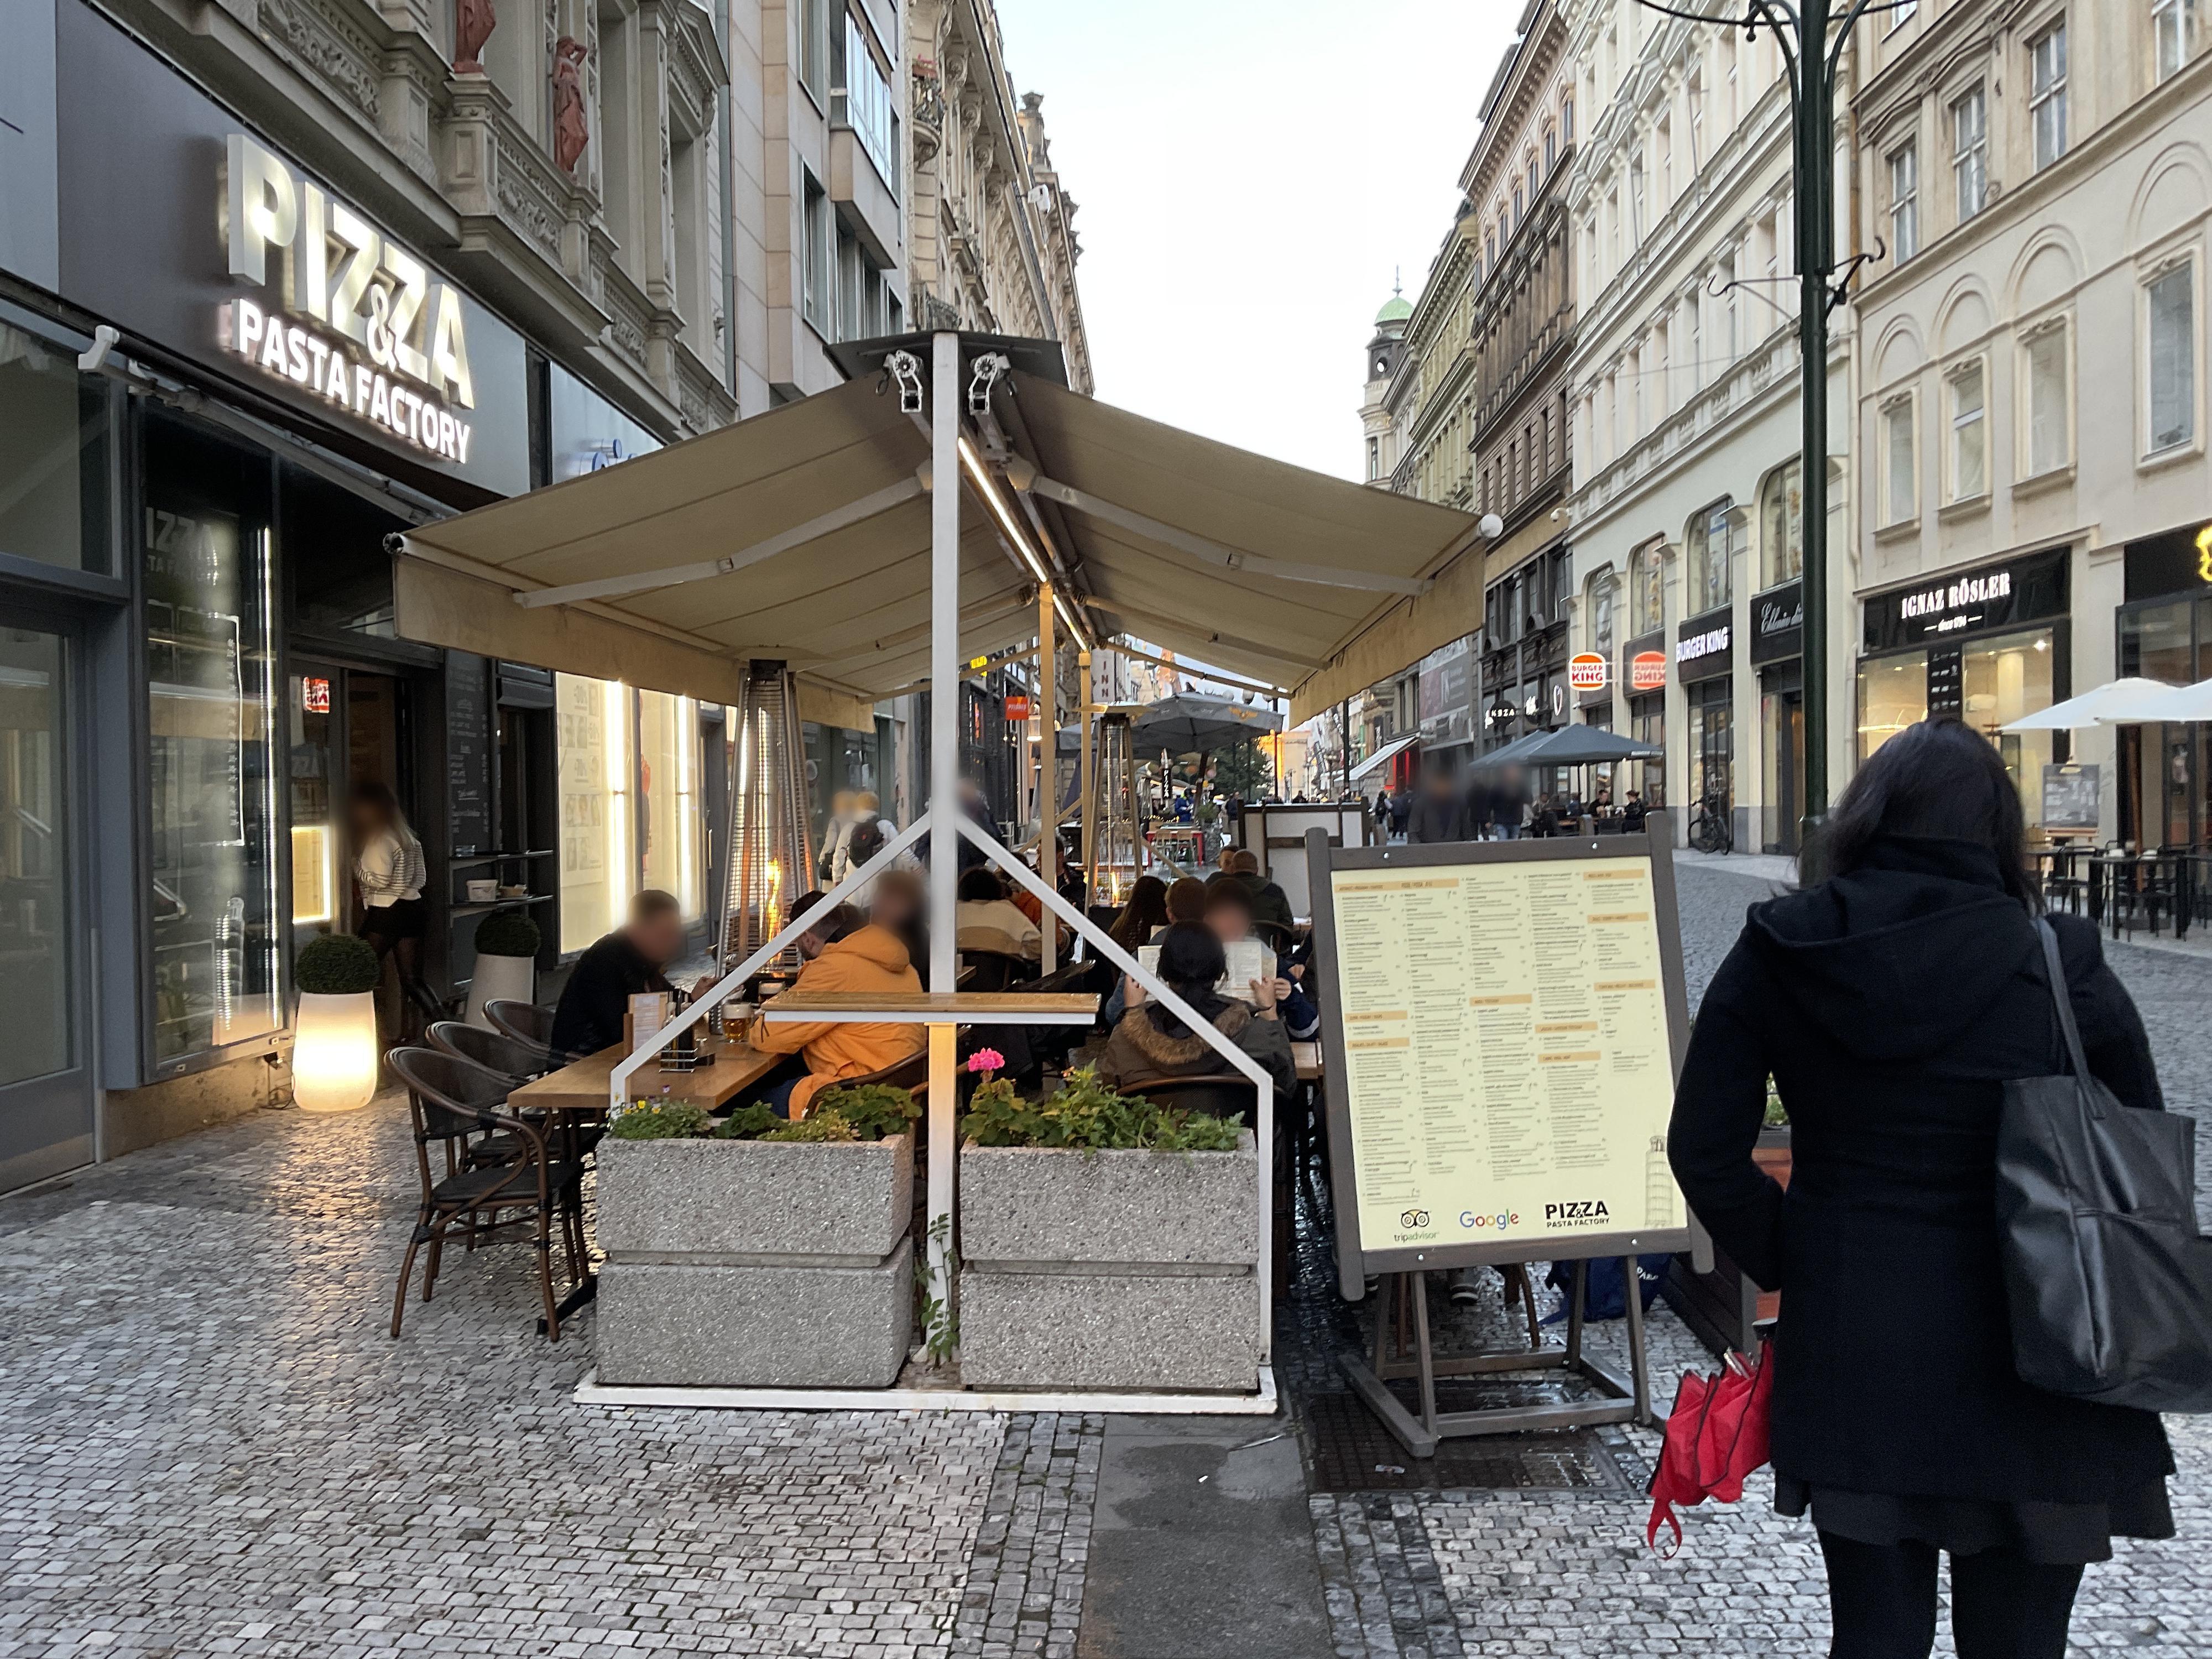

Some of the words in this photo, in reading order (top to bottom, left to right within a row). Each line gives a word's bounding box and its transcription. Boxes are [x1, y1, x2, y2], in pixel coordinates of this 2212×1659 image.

[227, 133, 474, 409] PIZZA
[231, 298, 348, 405] PASTA
[356, 364, 472, 464] FACTORY
[1901, 588, 1945, 619] IGNAZ
[1676, 634, 1706, 663] BURGER
[1705, 626, 1729, 654] KING
[1572, 672, 1603, 681] KING
[1459, 1209, 1520, 1230] Google
[1547, 1219, 1573, 1228] PASTA
[1574, 1217, 1610, 1226] FACTORY
[1394, 1230, 1438, 1243] tripadvisor
